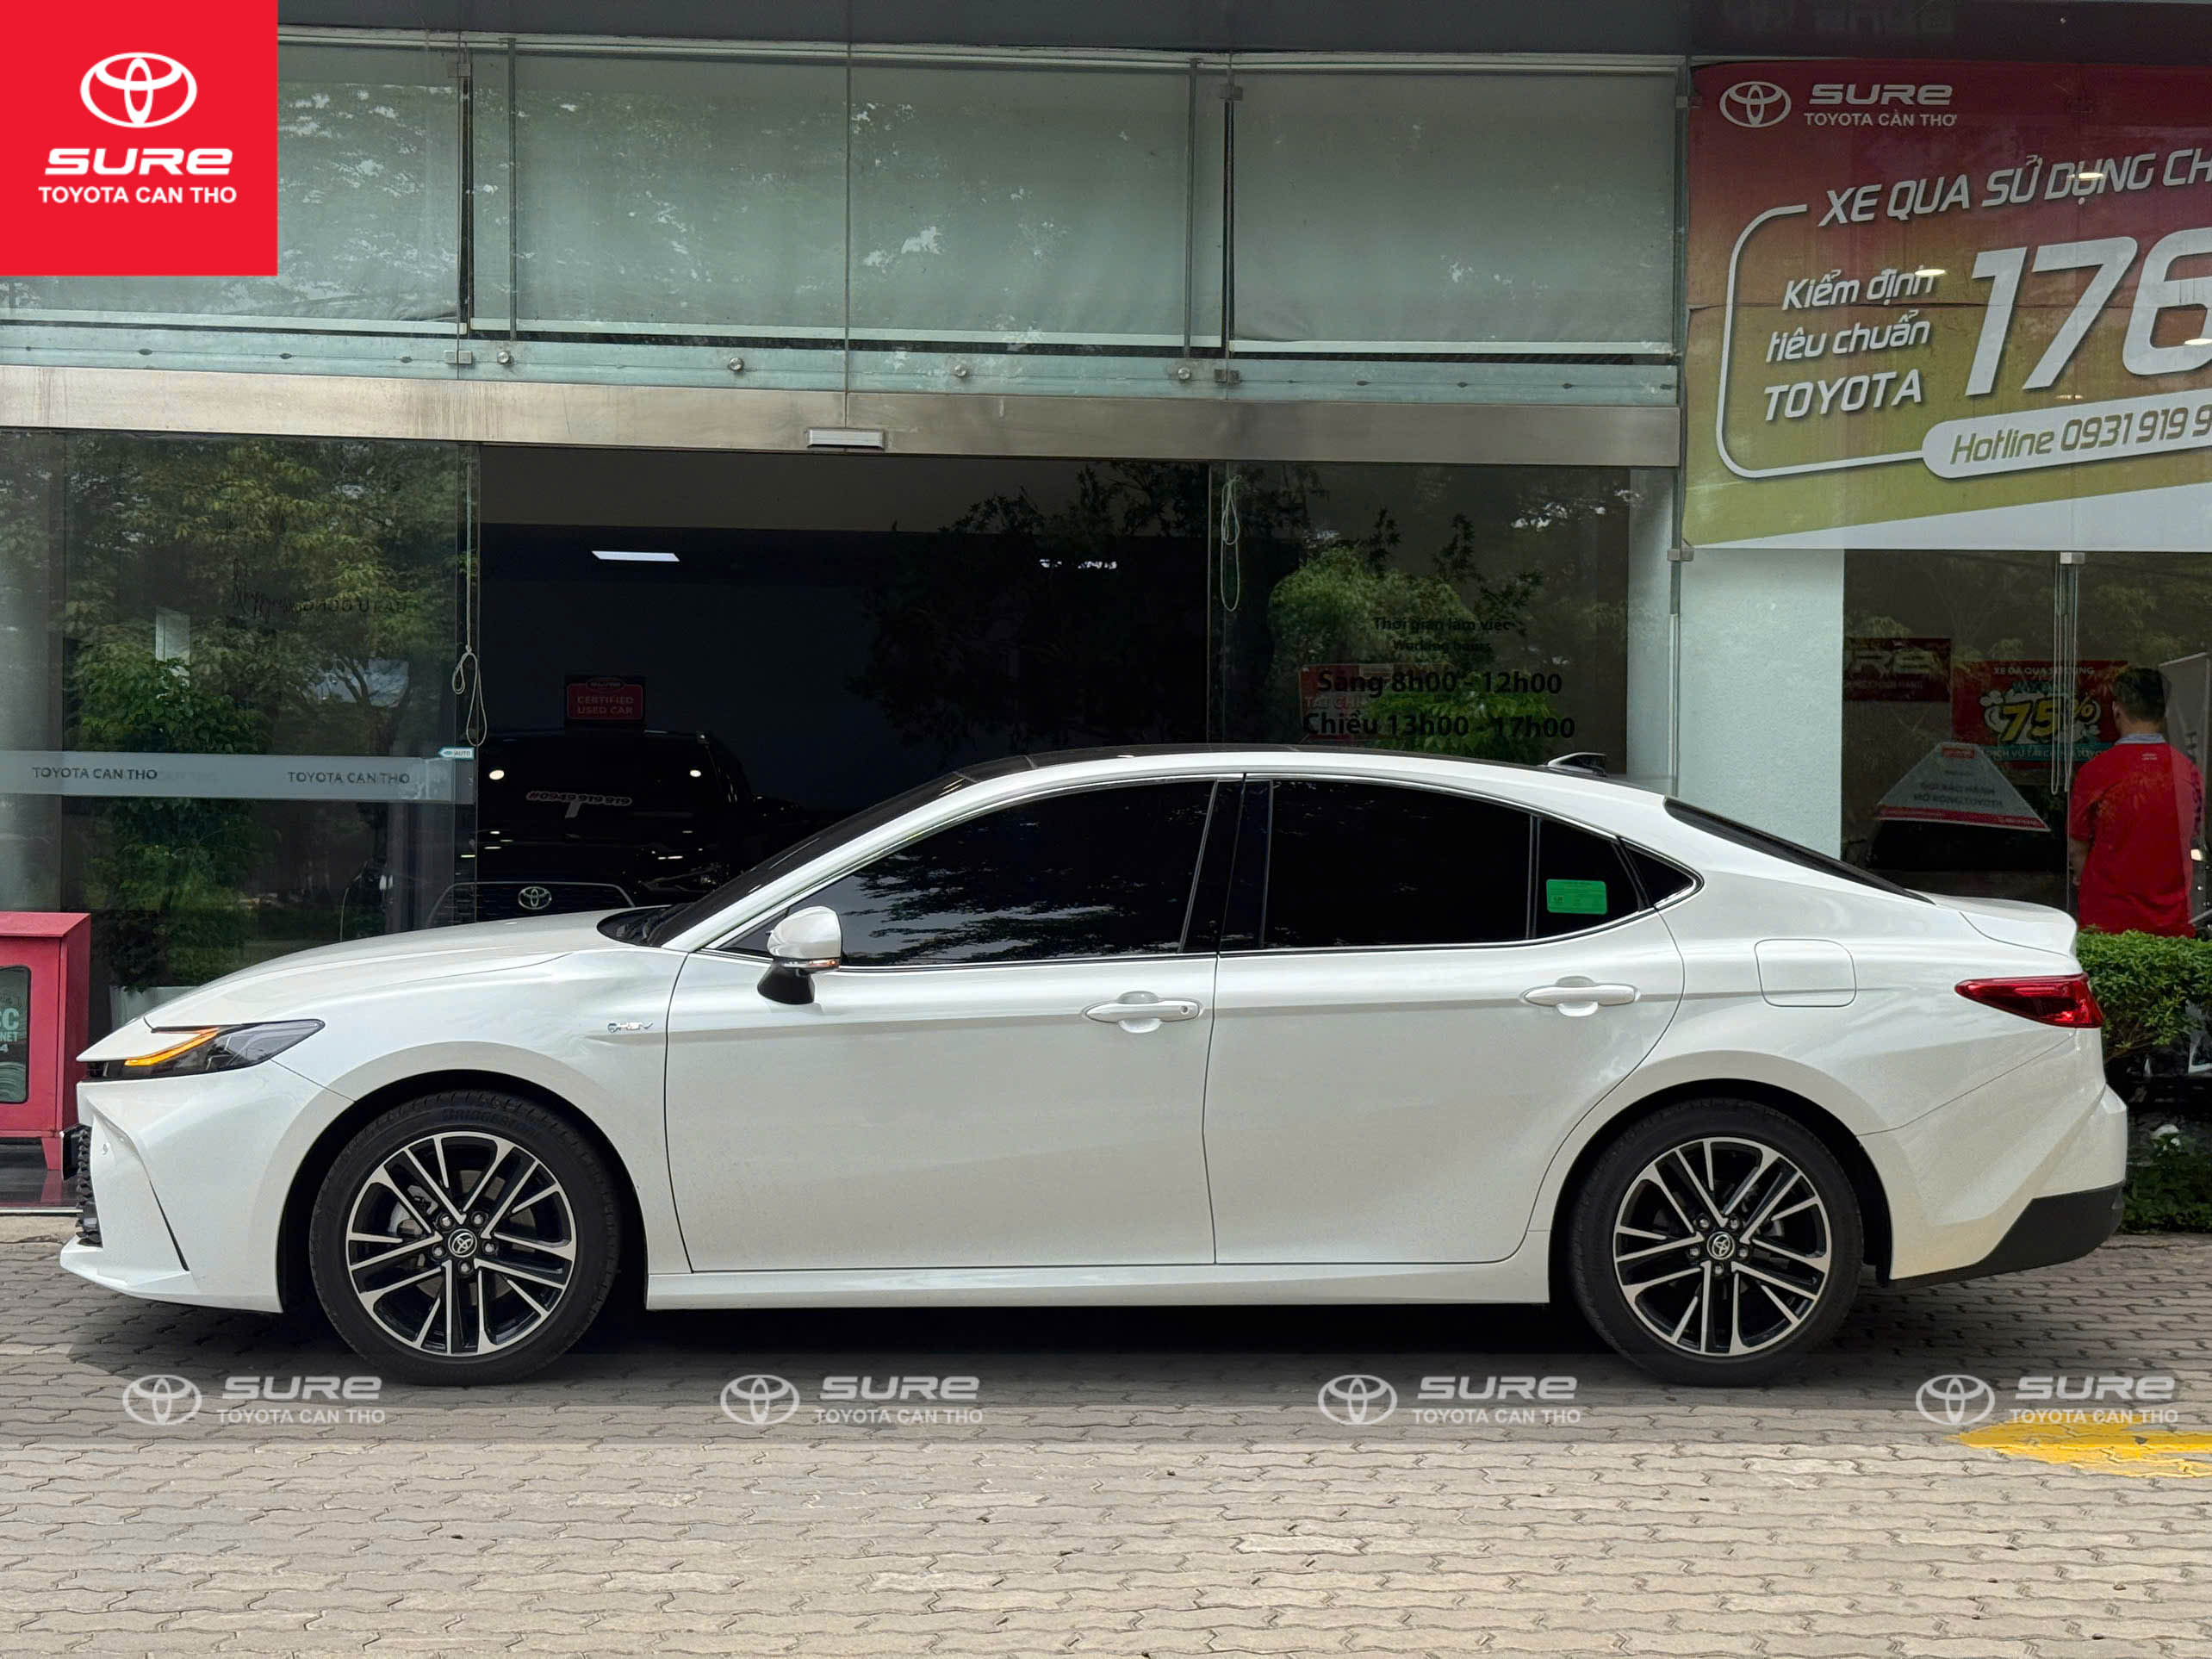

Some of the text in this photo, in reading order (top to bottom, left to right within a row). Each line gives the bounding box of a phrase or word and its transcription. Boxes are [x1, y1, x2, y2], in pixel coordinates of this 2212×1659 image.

[1804, 113, 1873, 126] TOYOTA
[1920, 113, 1958, 127] THƠ
[1817, 184, 1881, 227] XE
[1886, 174, 1970, 221] QUA
[1981, 155, 2043, 208] SỬ
[2044, 152, 2157, 205] DỤNG
[1781, 264, 1937, 311] Kiểm định
[1965, 227, 2212, 396] 176
[1766, 308, 1931, 363] tiêu chuẩn
[1764, 369, 1923, 421] TOYOTA
[1949, 427, 2055, 465] Hotline
[2060, 412, 2134, 451] 0931
[2135, 407, 2189, 444] 919
[1391, 671, 1457, 694] 8h00
[1484, 672, 1563, 695] 12h00
[576, 695, 635, 705] CERTIFIED
[577, 705, 634, 716] USED CAR
[1302, 710, 1381, 736] Chiều
[1389, 714, 1469, 737] 13h00
[1495, 716, 1576, 739] 17h00
[32, 767, 90, 779] TOYOTA
[93, 767, 124, 780] CAN
[127, 768, 158, 780] THO
[287, 771, 411, 785] TOYOTA CAN THO
